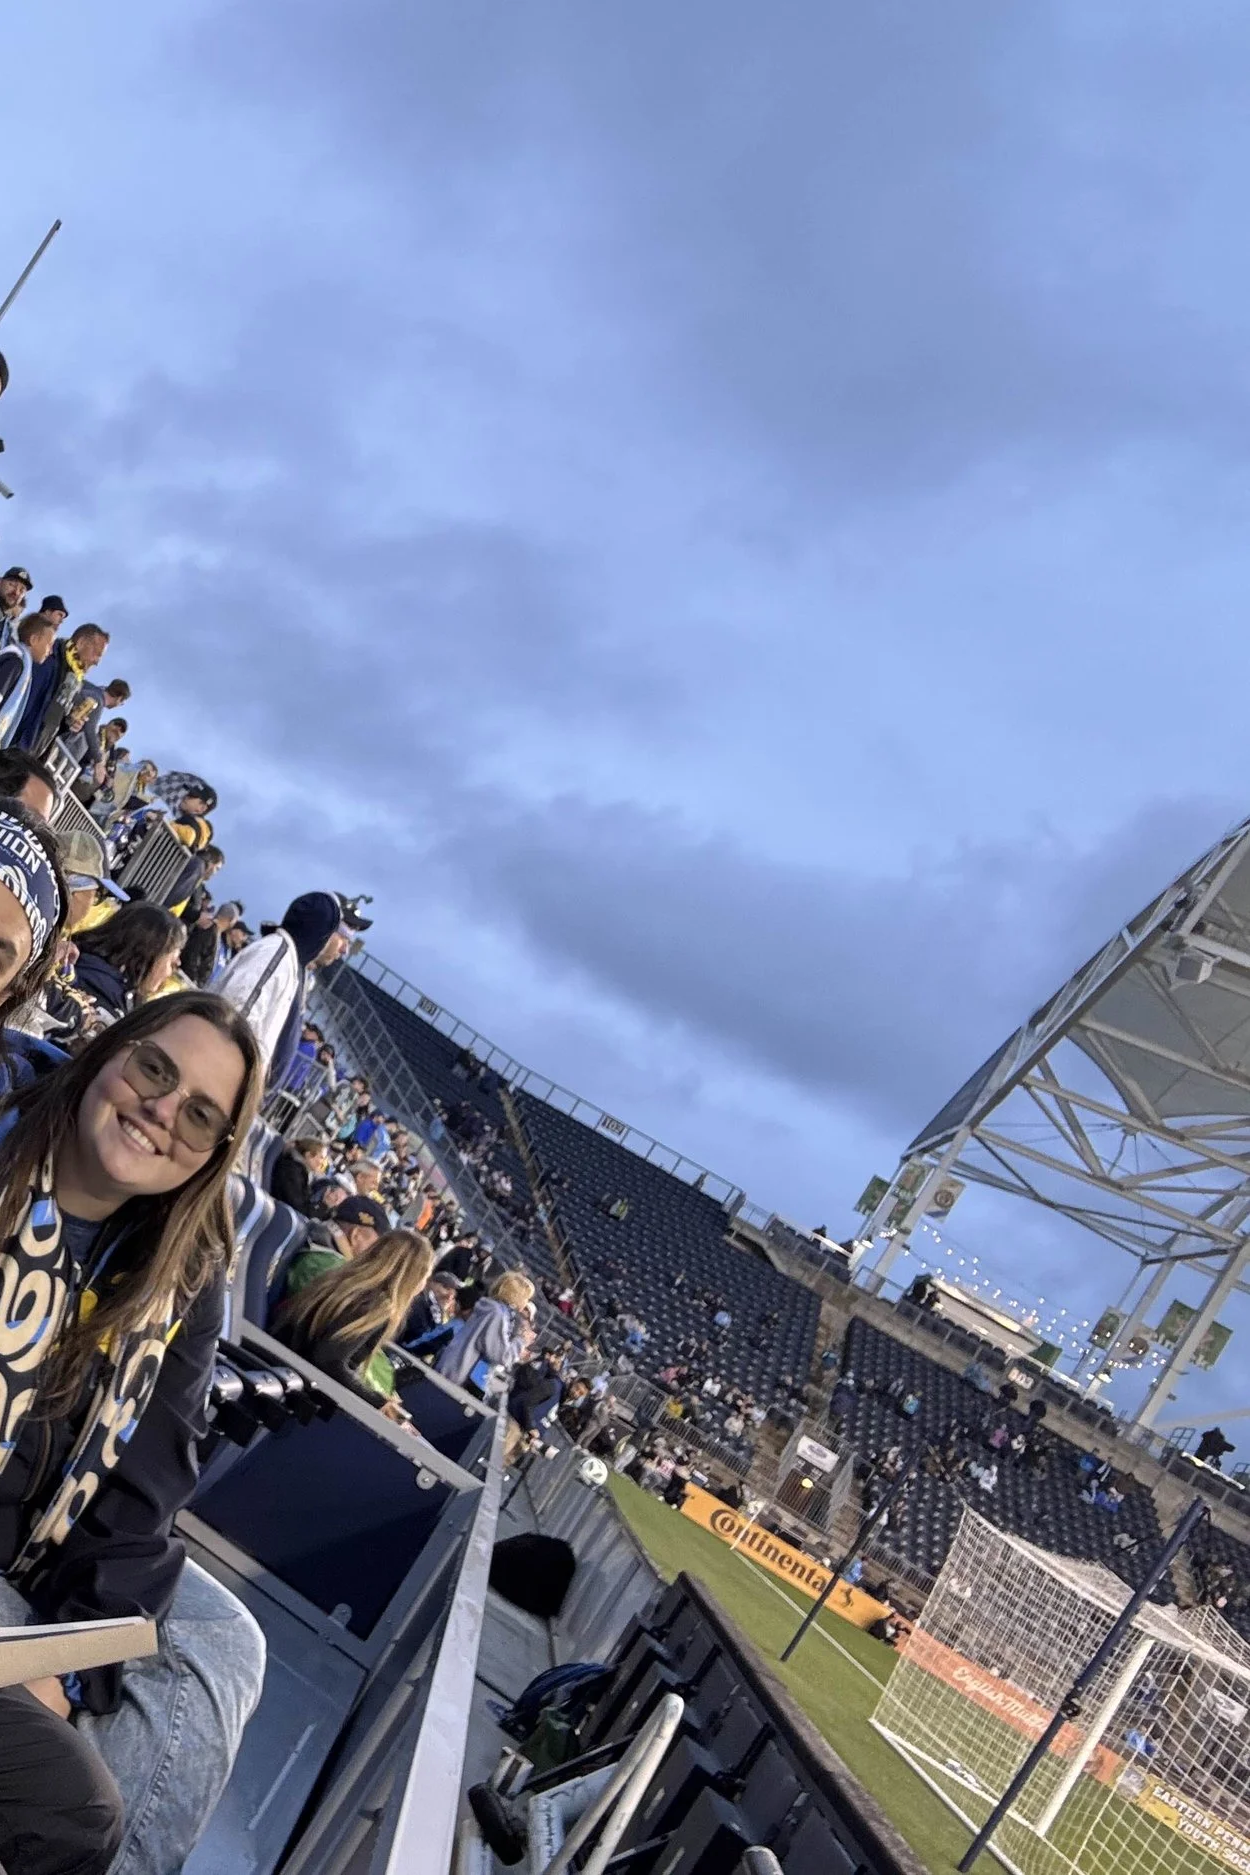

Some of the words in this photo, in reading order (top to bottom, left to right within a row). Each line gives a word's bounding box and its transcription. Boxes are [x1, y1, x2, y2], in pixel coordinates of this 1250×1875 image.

[710, 1509, 827, 1592] Continenta
[1152, 1785, 1213, 1829] EASTERN
[1178, 1817, 1221, 1851] YOUTH
